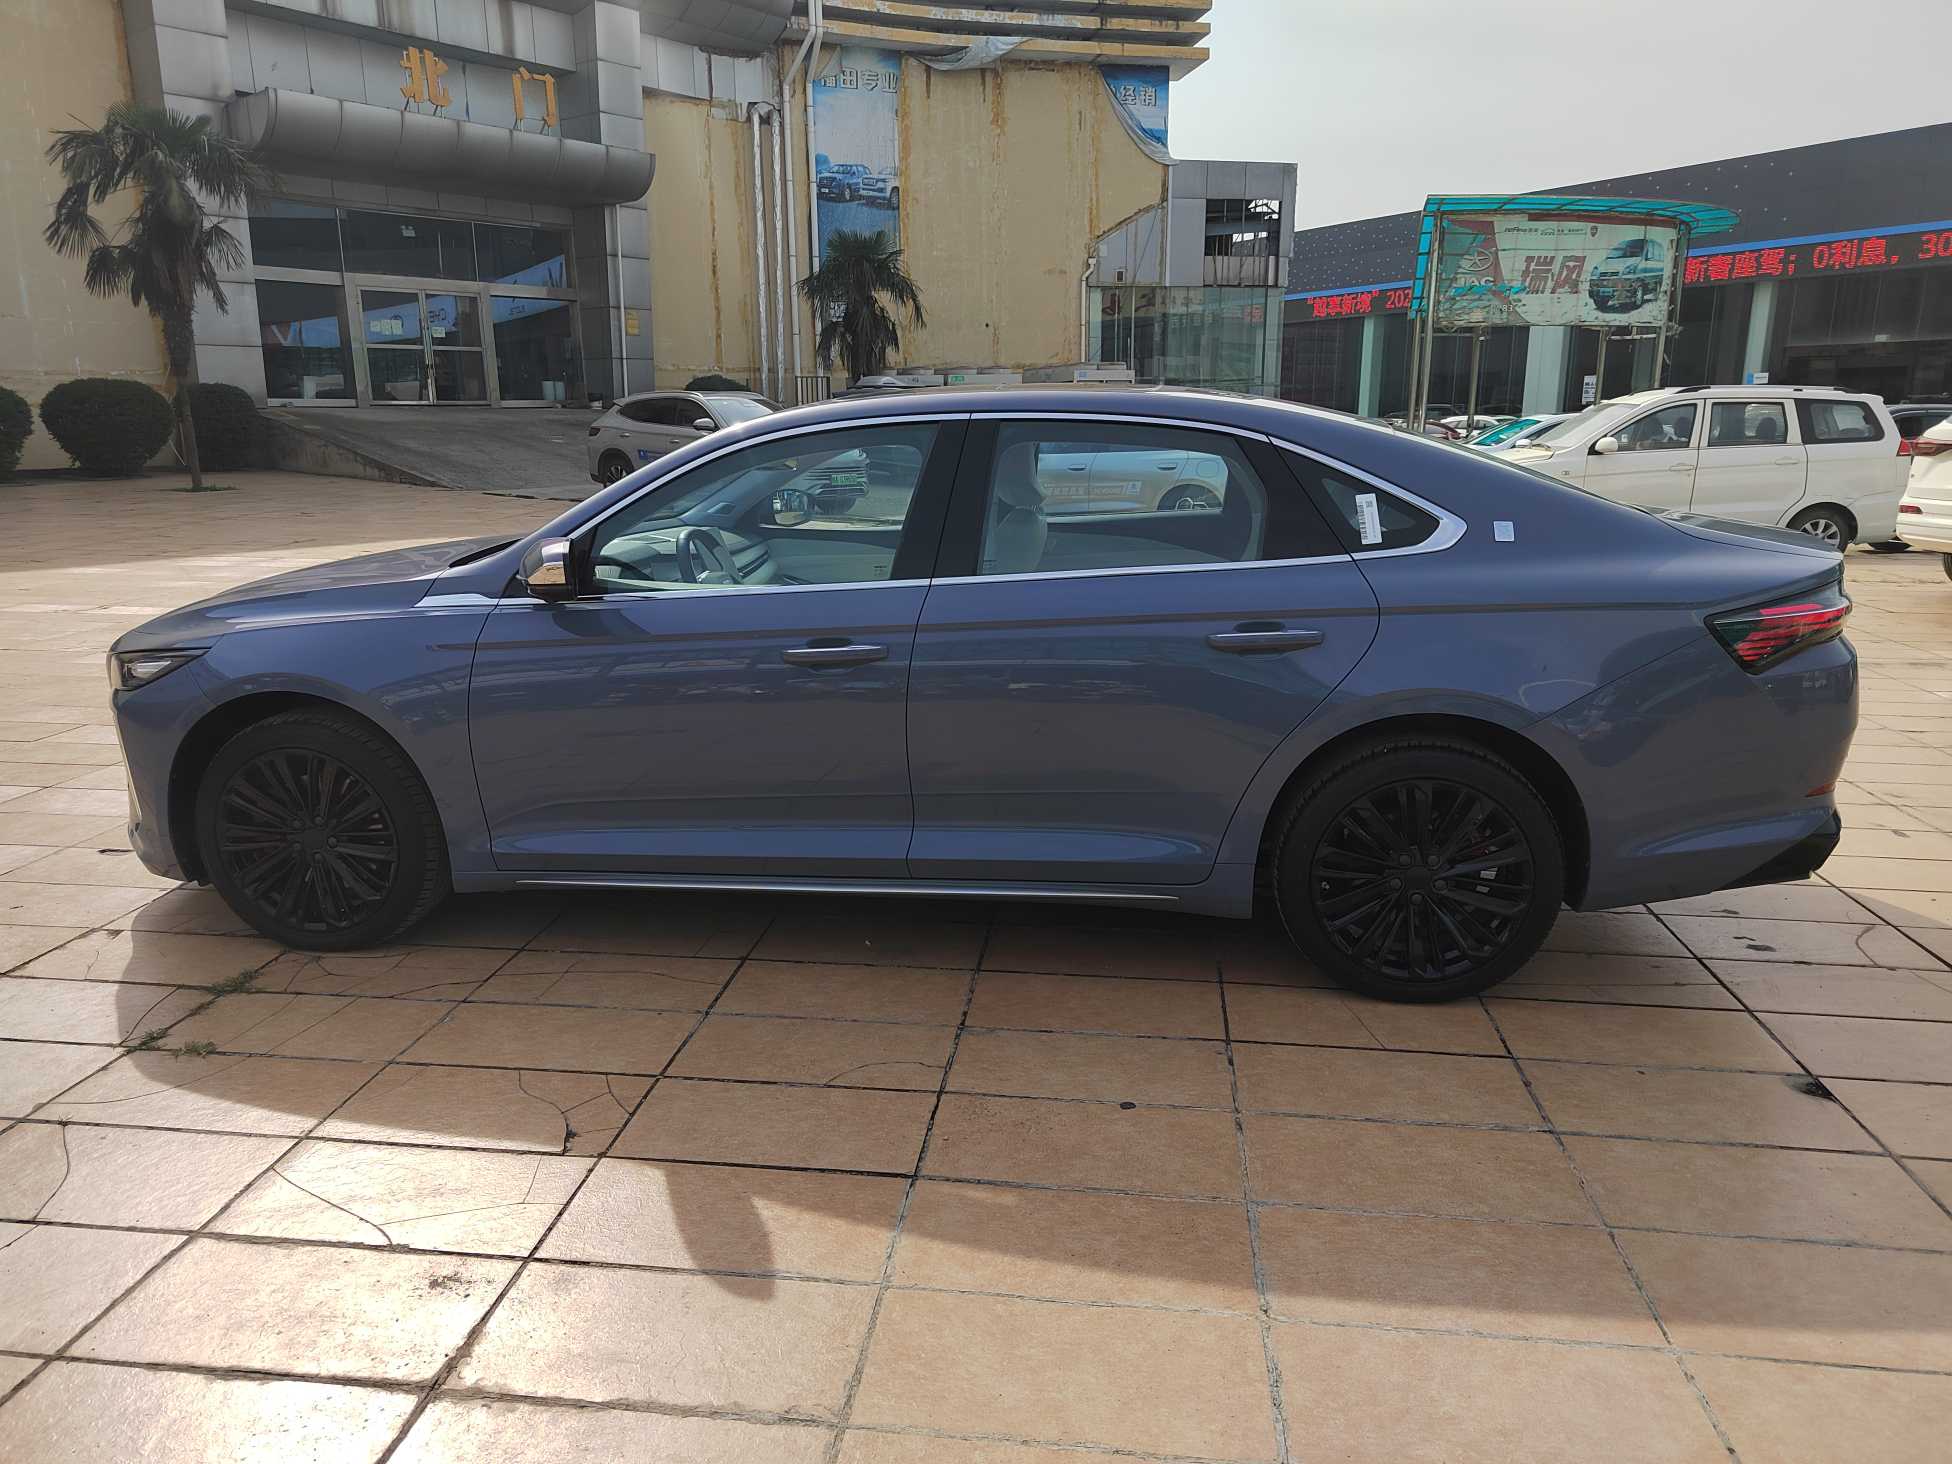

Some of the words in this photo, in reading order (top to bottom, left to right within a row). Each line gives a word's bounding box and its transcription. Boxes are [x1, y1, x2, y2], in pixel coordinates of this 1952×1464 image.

[400, 46, 558, 128] 北门
[1109, 84, 1157, 107] 经销
[1521, 255, 1587, 295] 瑞风
